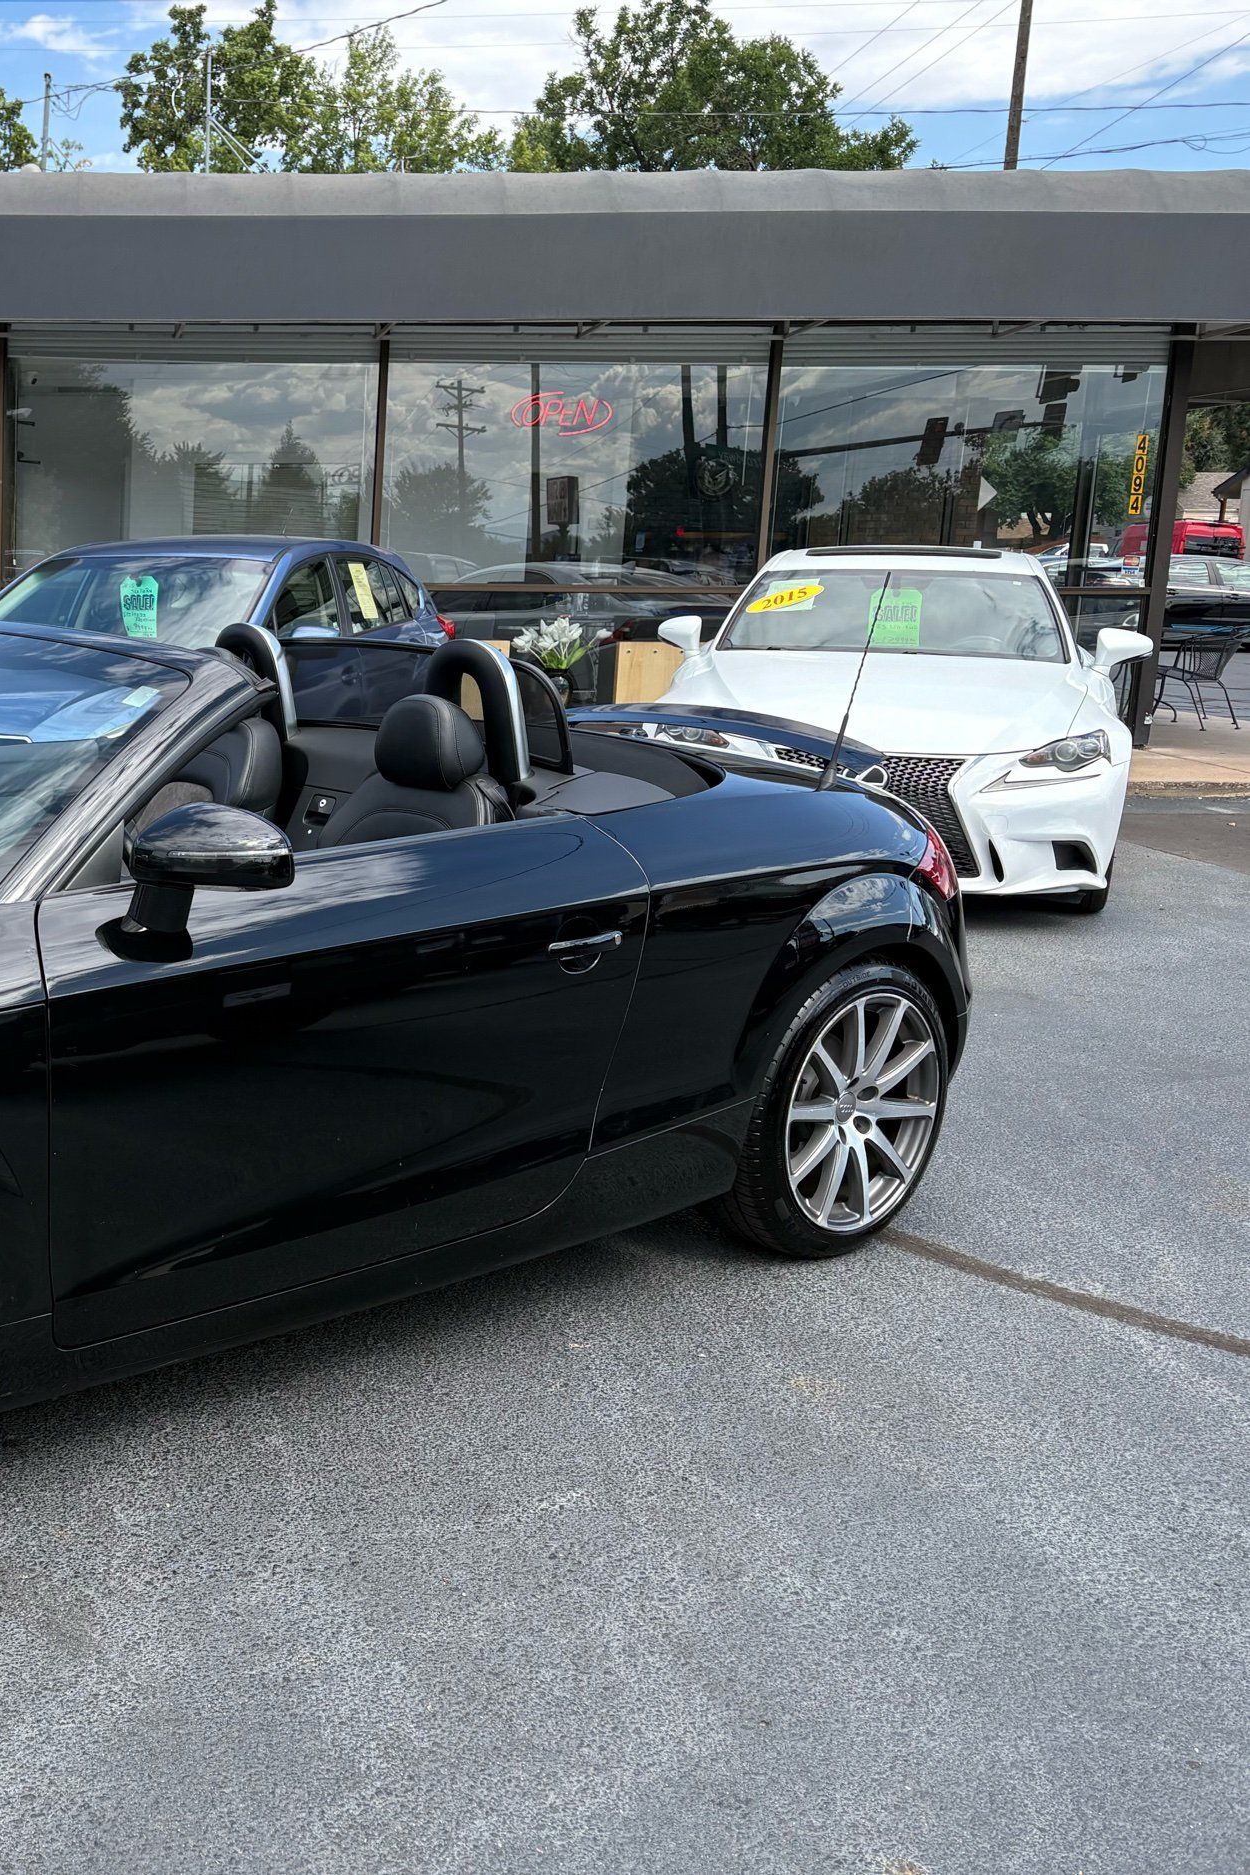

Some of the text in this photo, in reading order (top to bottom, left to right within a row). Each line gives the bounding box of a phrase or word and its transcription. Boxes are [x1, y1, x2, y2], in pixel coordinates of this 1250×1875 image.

[521, 398, 600, 428] OPEN
[1128, 436, 1147, 514] 4094
[123, 593, 155, 611] SALE!
[762, 587, 808, 610] 2015
[873, 605, 918, 622] SALE!
